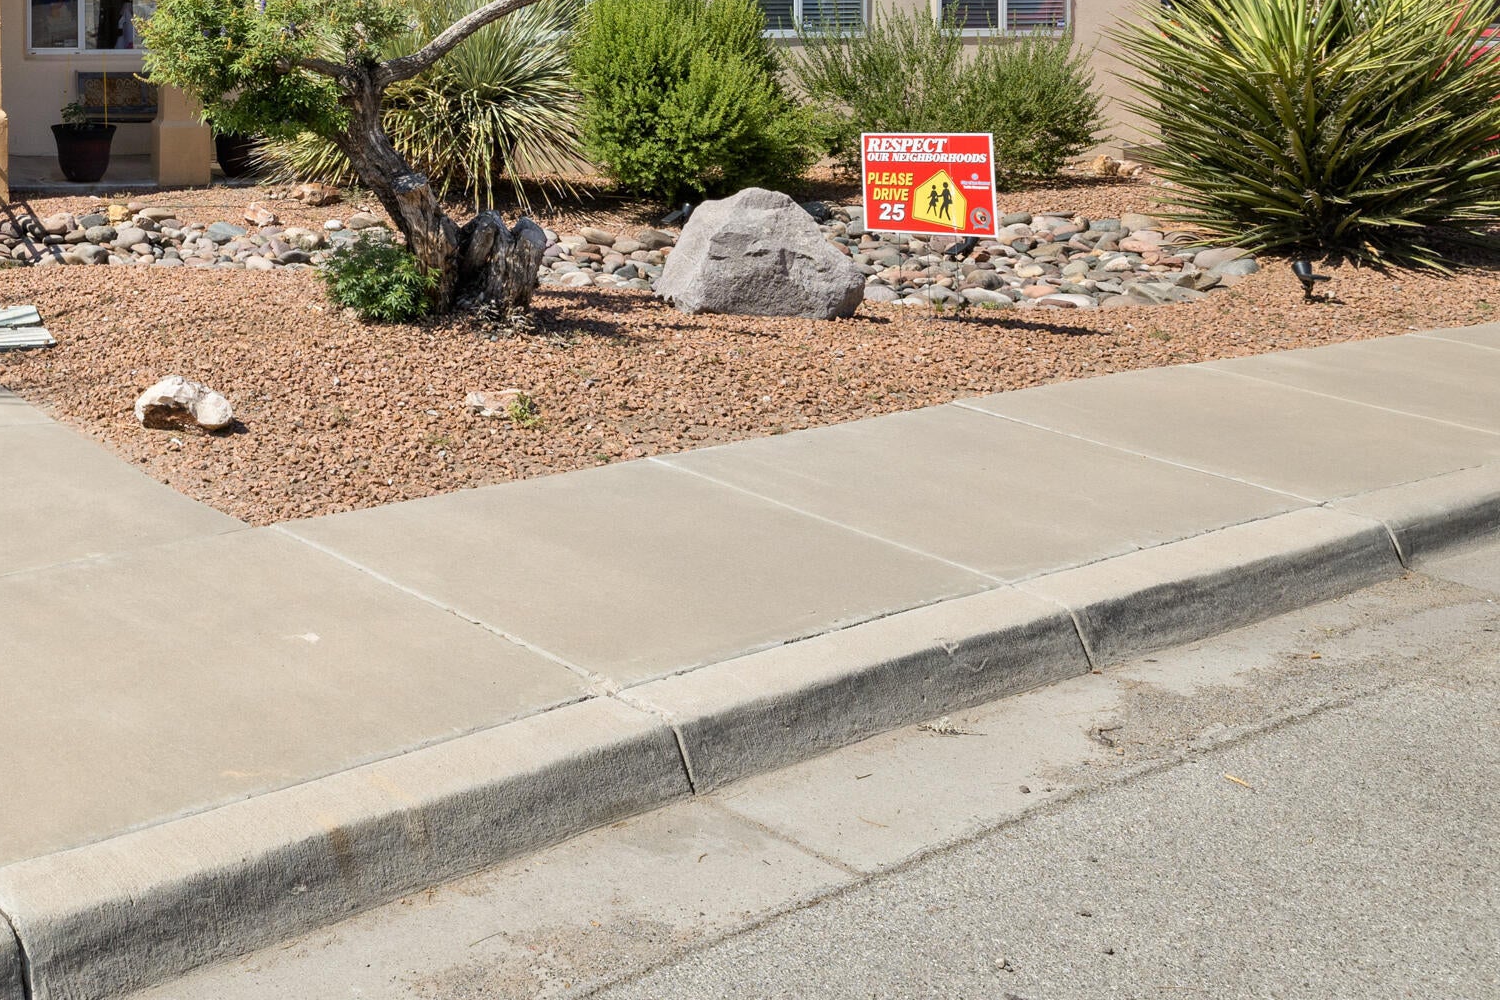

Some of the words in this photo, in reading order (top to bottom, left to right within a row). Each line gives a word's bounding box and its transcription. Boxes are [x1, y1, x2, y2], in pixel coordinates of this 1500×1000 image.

[866, 137, 948, 153] RESPECT
[867, 153, 889, 162] OUR
[891, 153, 987, 163] NEIGHBORHOODS
[867, 172, 913, 186] PLEASE
[873, 188, 909, 201] DRIVE
[878, 203, 905, 221] 25
